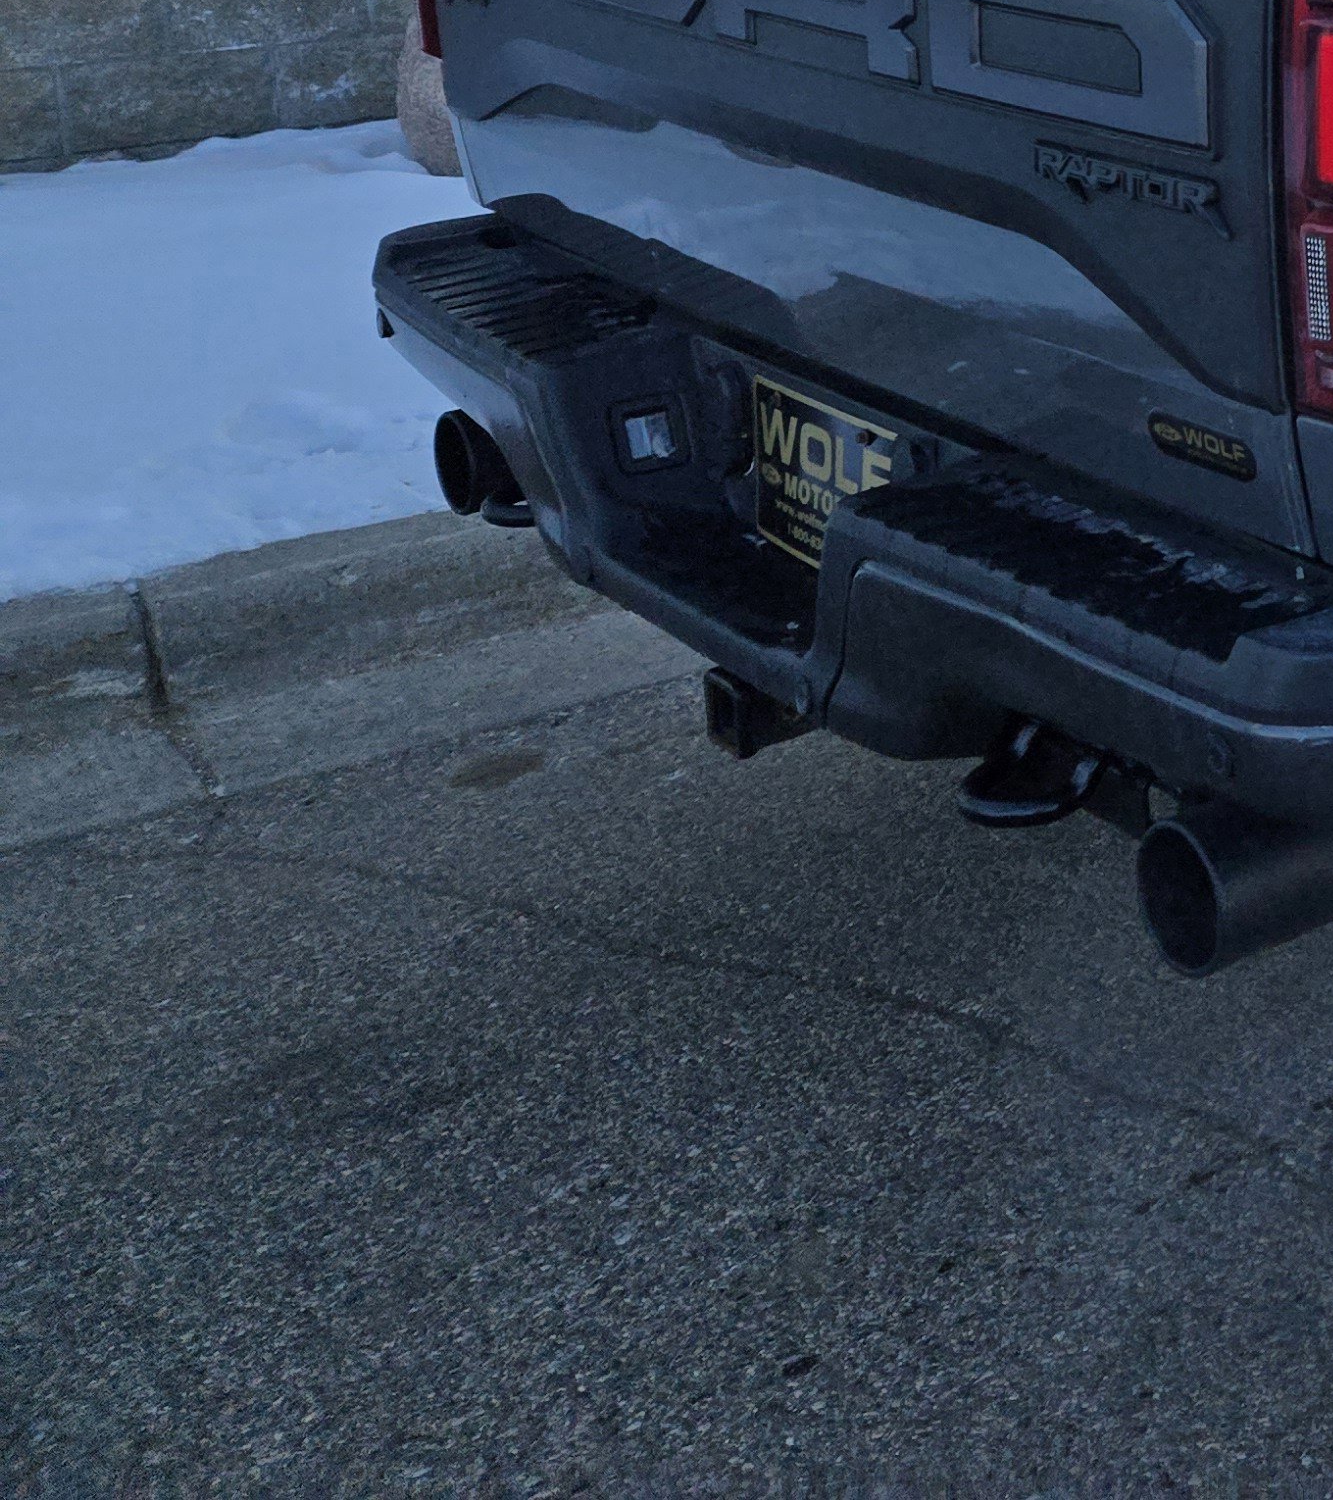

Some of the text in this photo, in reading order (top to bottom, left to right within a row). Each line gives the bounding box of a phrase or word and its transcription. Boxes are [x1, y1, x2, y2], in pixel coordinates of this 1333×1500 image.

[1034, 141, 1234, 240] RAPTOR
[760, 402, 892, 495] WOLF
[1183, 426, 1246, 462] WOLF
[784, 472, 842, 515] MOTO
